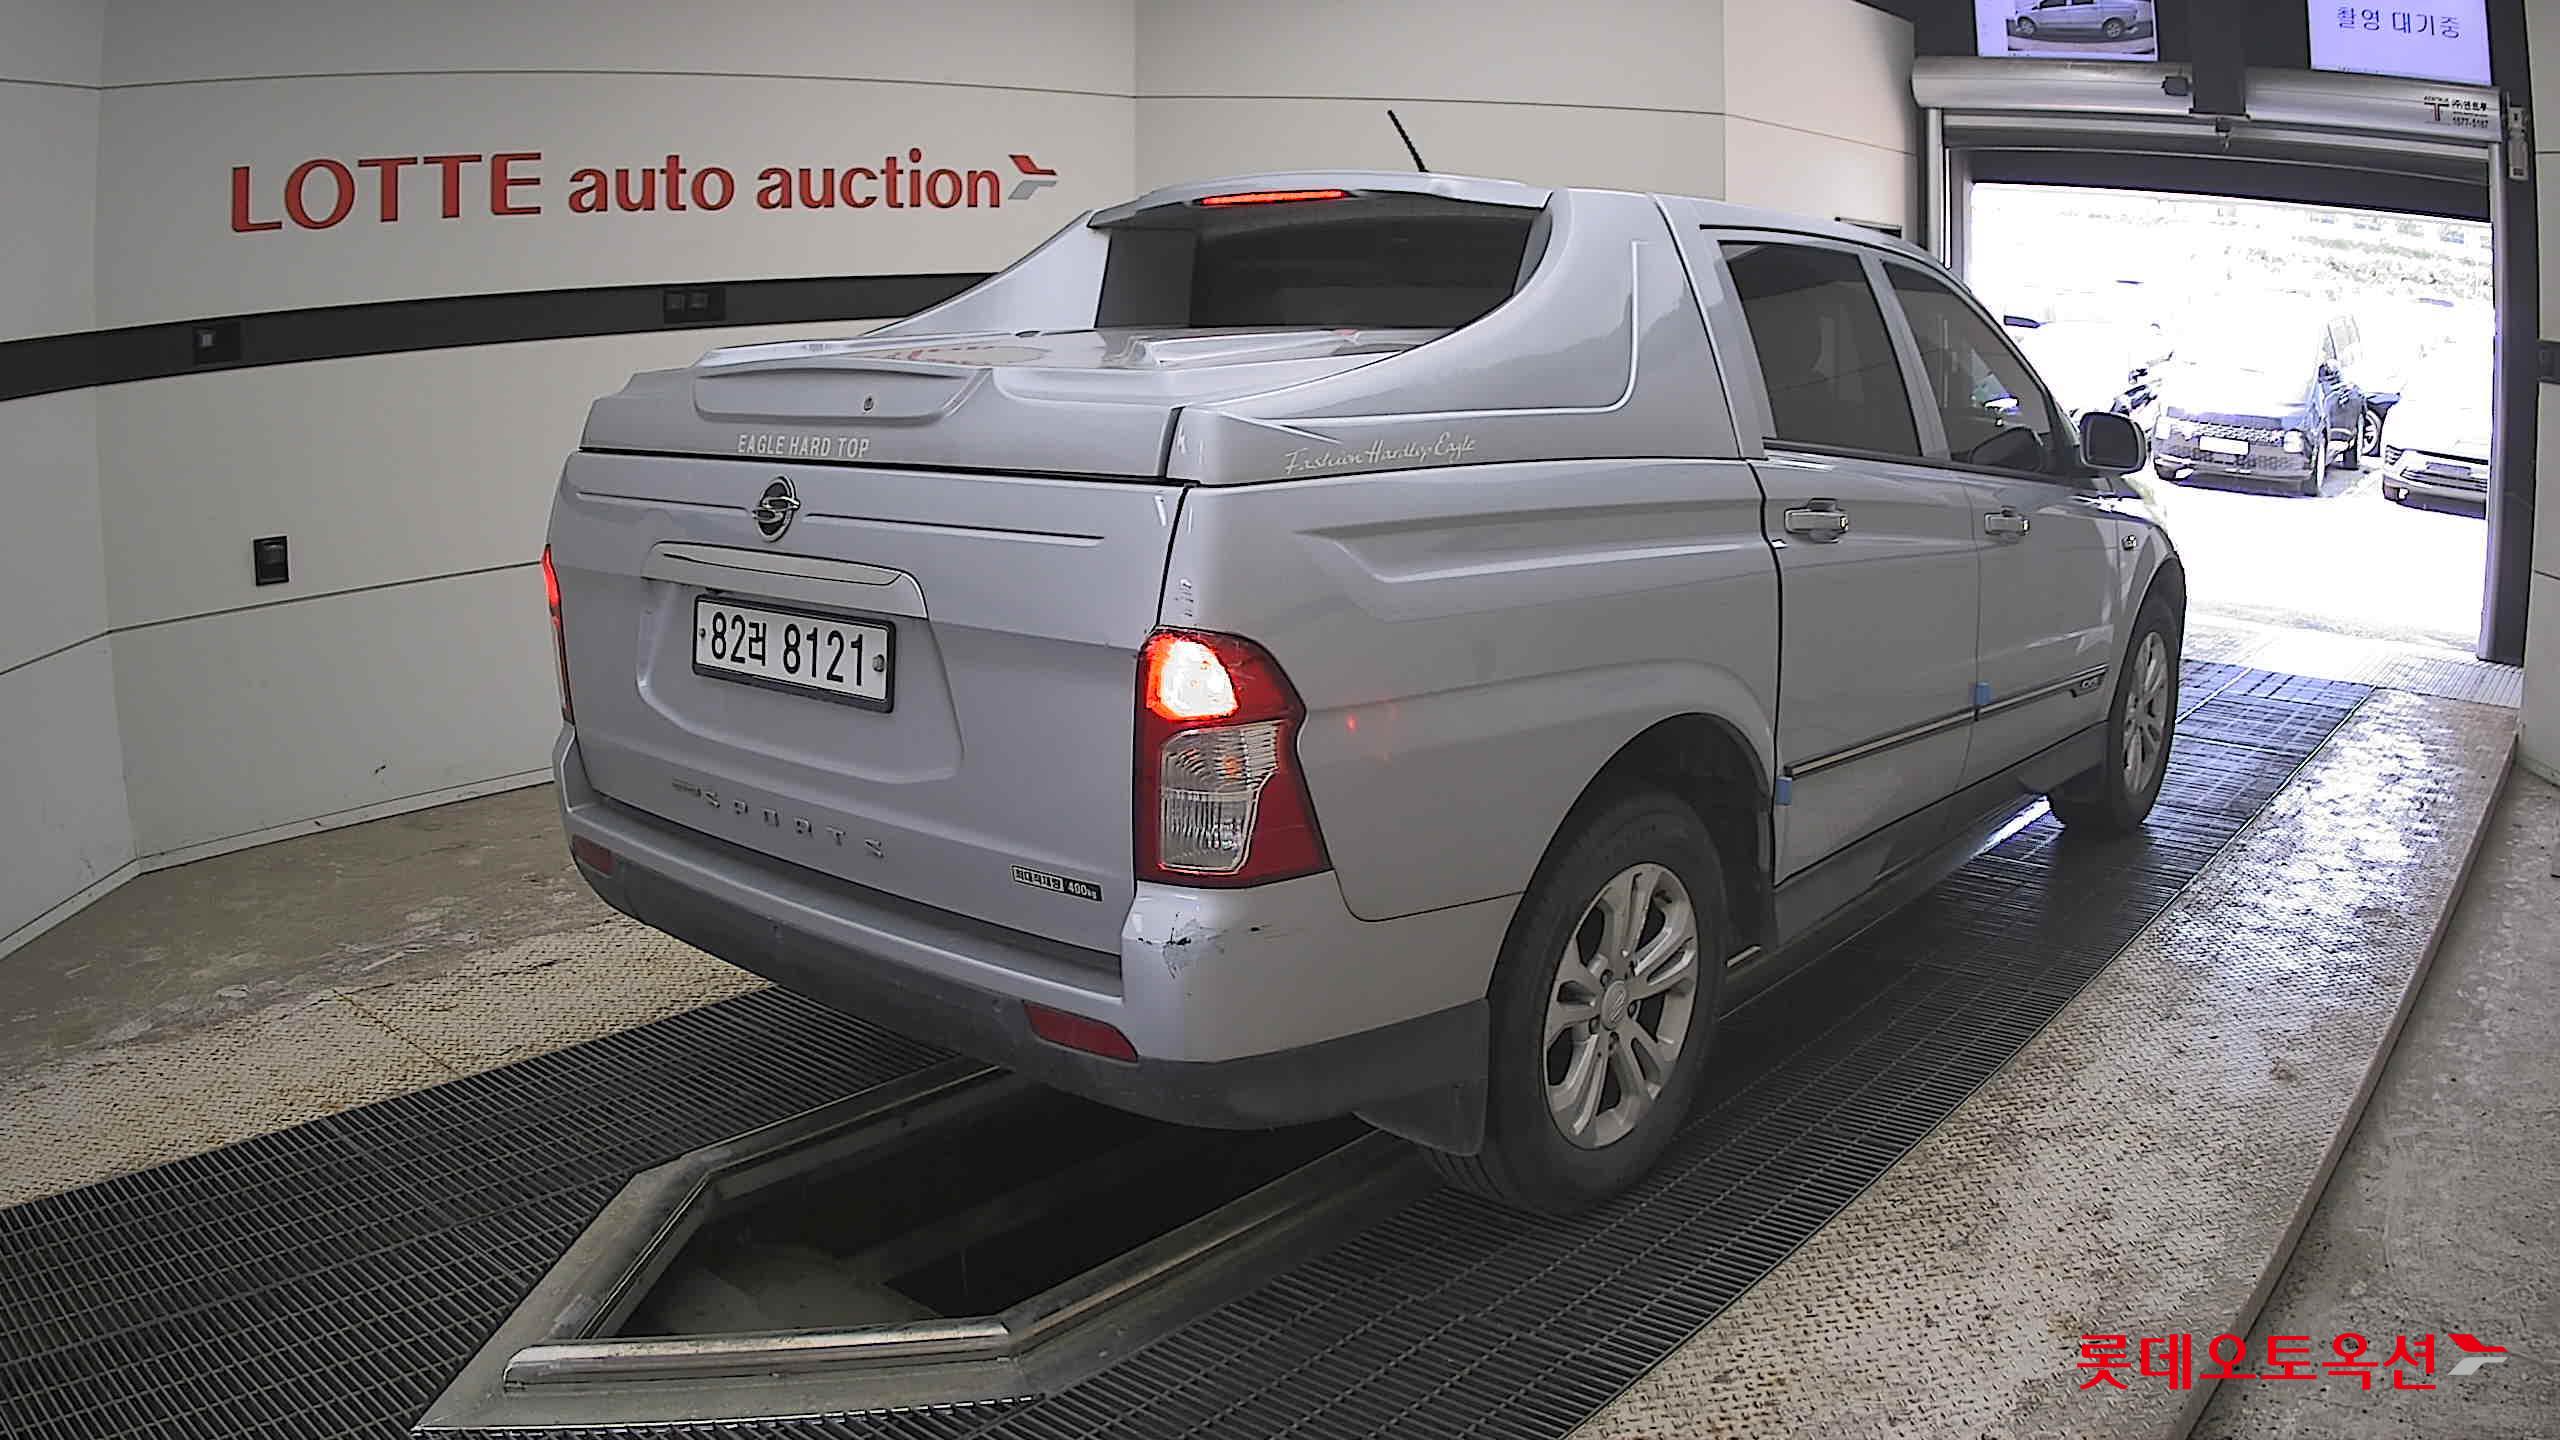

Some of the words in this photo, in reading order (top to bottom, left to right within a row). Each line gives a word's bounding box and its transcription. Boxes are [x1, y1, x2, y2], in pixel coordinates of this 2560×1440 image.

[2336, 6, 2380, 31] 촬영
[2392, 12, 2460, 39] 대기중
[231, 151, 542, 233] LOTTE
[568, 155, 735, 213] auto
[757, 148, 1000, 209] auction
[738, 434, 786, 455] EAGLE
[789, 435, 832, 457] HARD
[837, 437, 870, 458] TOP
[711, 611, 767, 667] 82러
[783, 623, 864, 687] 8121
